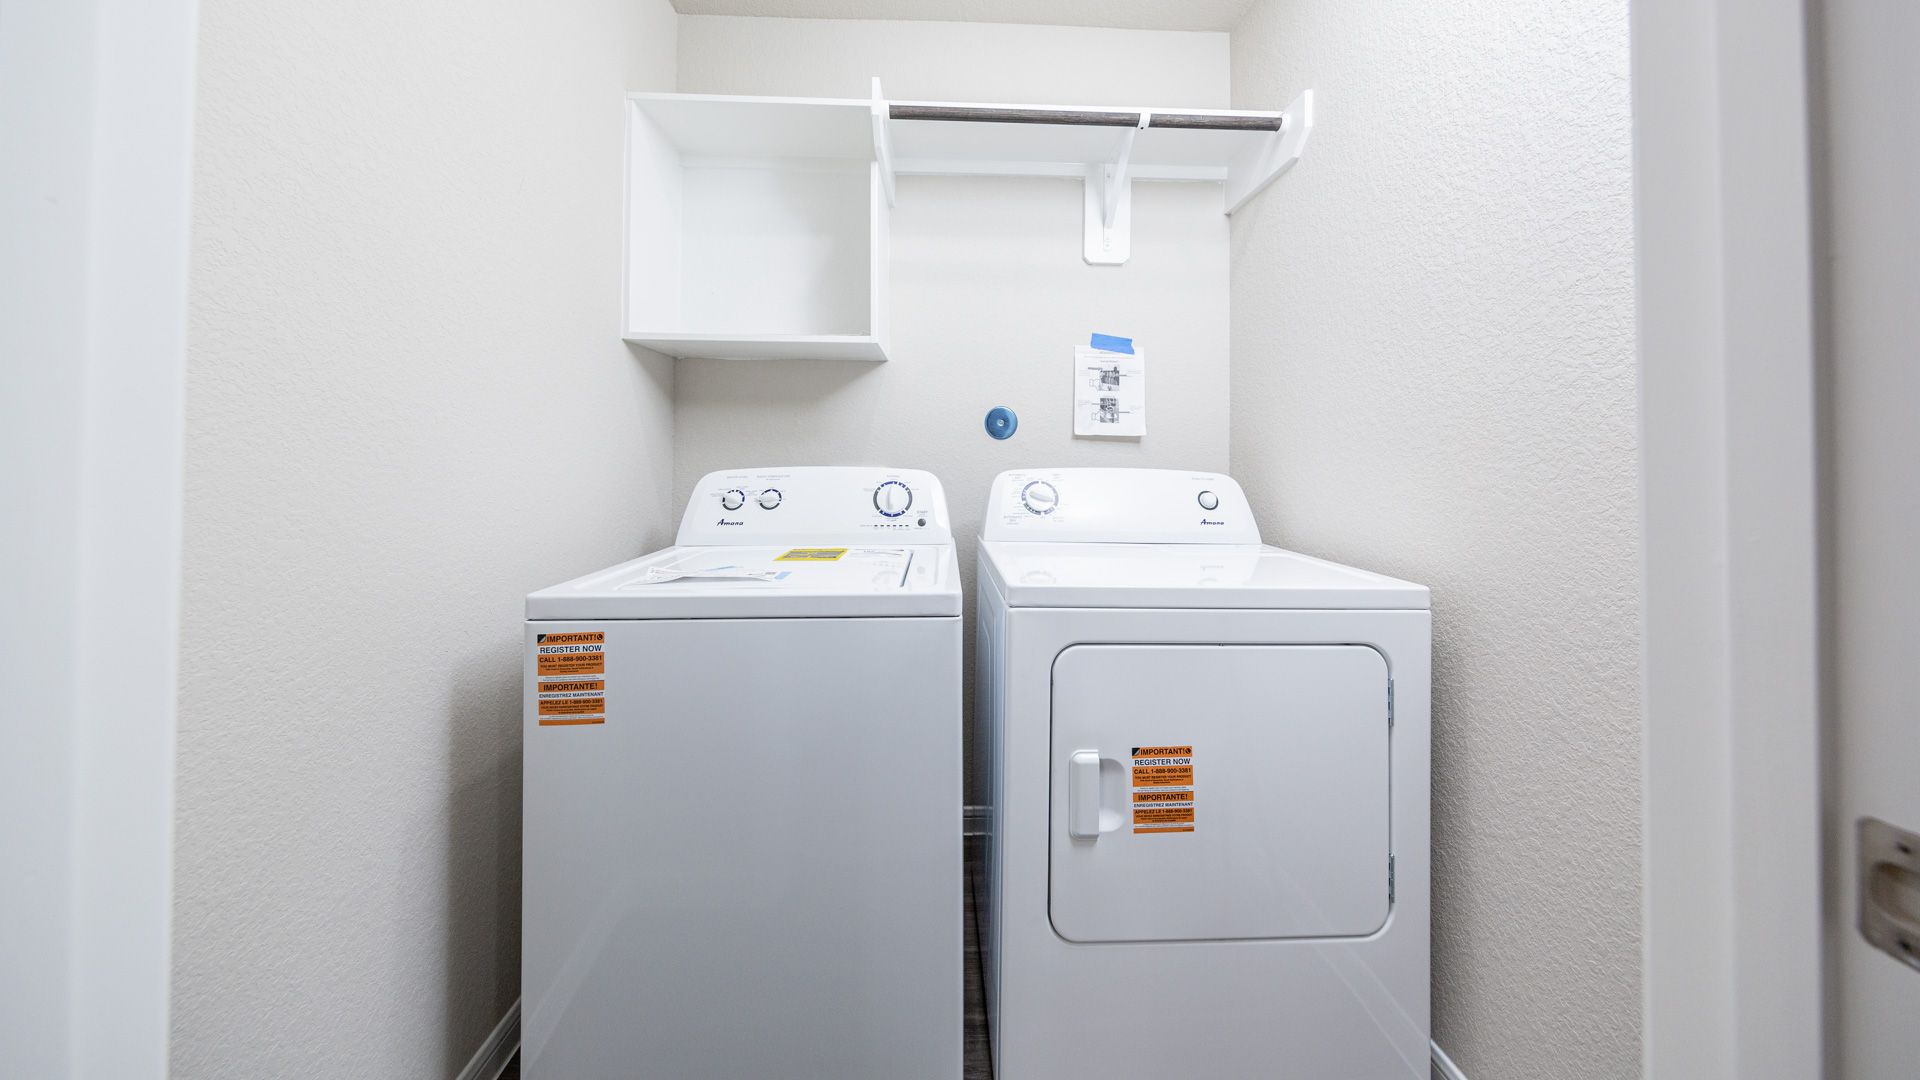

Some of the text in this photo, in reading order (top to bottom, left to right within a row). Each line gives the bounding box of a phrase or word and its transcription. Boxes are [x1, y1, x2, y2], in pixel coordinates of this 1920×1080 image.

[717, 518, 744, 526] Amana
[1200, 518, 1225, 526] Amana
[547, 633, 596, 643] IMPORTANT!
[540, 646, 580, 654] REGISTER
[543, 682, 598, 691] IMPORTANTE!
[1140, 748, 1185, 756] IMPORTANT!
[1138, 793, 1188, 801] IMPORTANTE!
